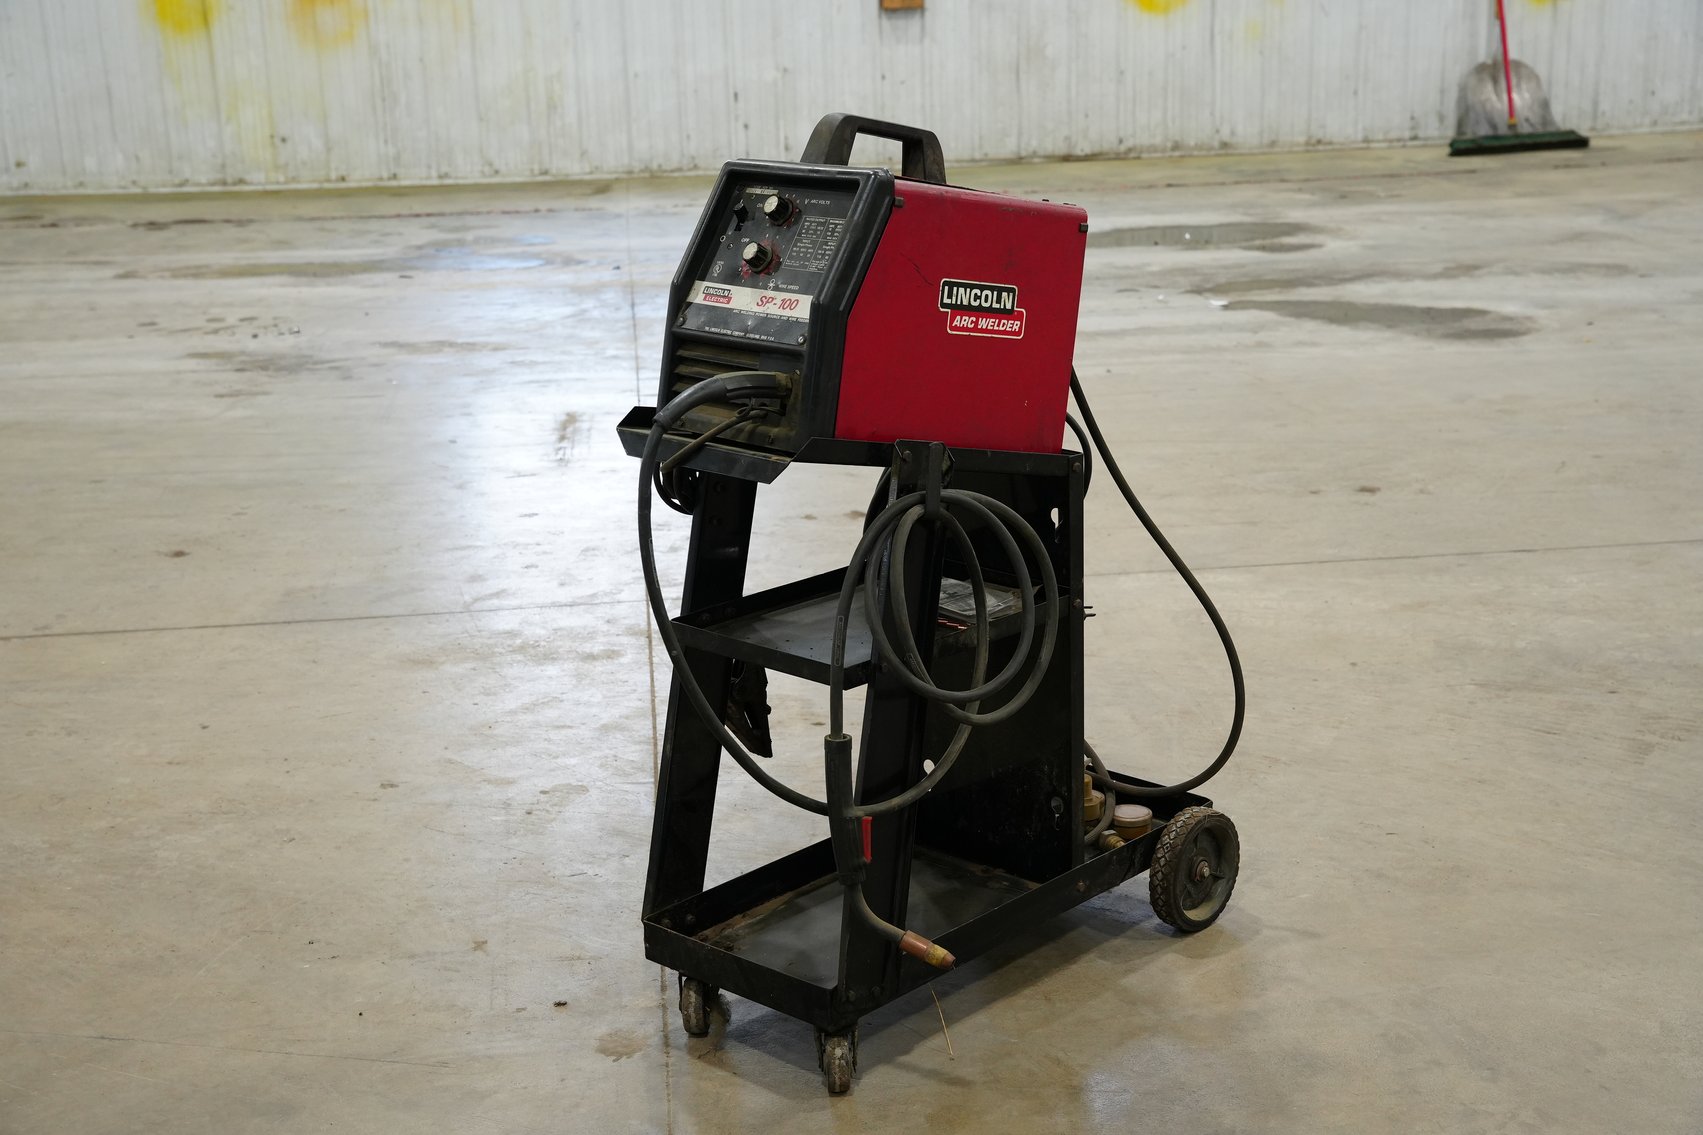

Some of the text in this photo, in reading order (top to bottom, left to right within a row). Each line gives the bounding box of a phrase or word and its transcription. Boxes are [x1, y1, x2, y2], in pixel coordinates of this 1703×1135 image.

[703, 286, 730, 296] LINCOLN
[943, 286, 1013, 309] LINCOLN
[705, 296, 729, 304] ELECTRIC
[756, 295, 800, 311] SP-100
[952, 315, 1020, 331] ARC WELDER
